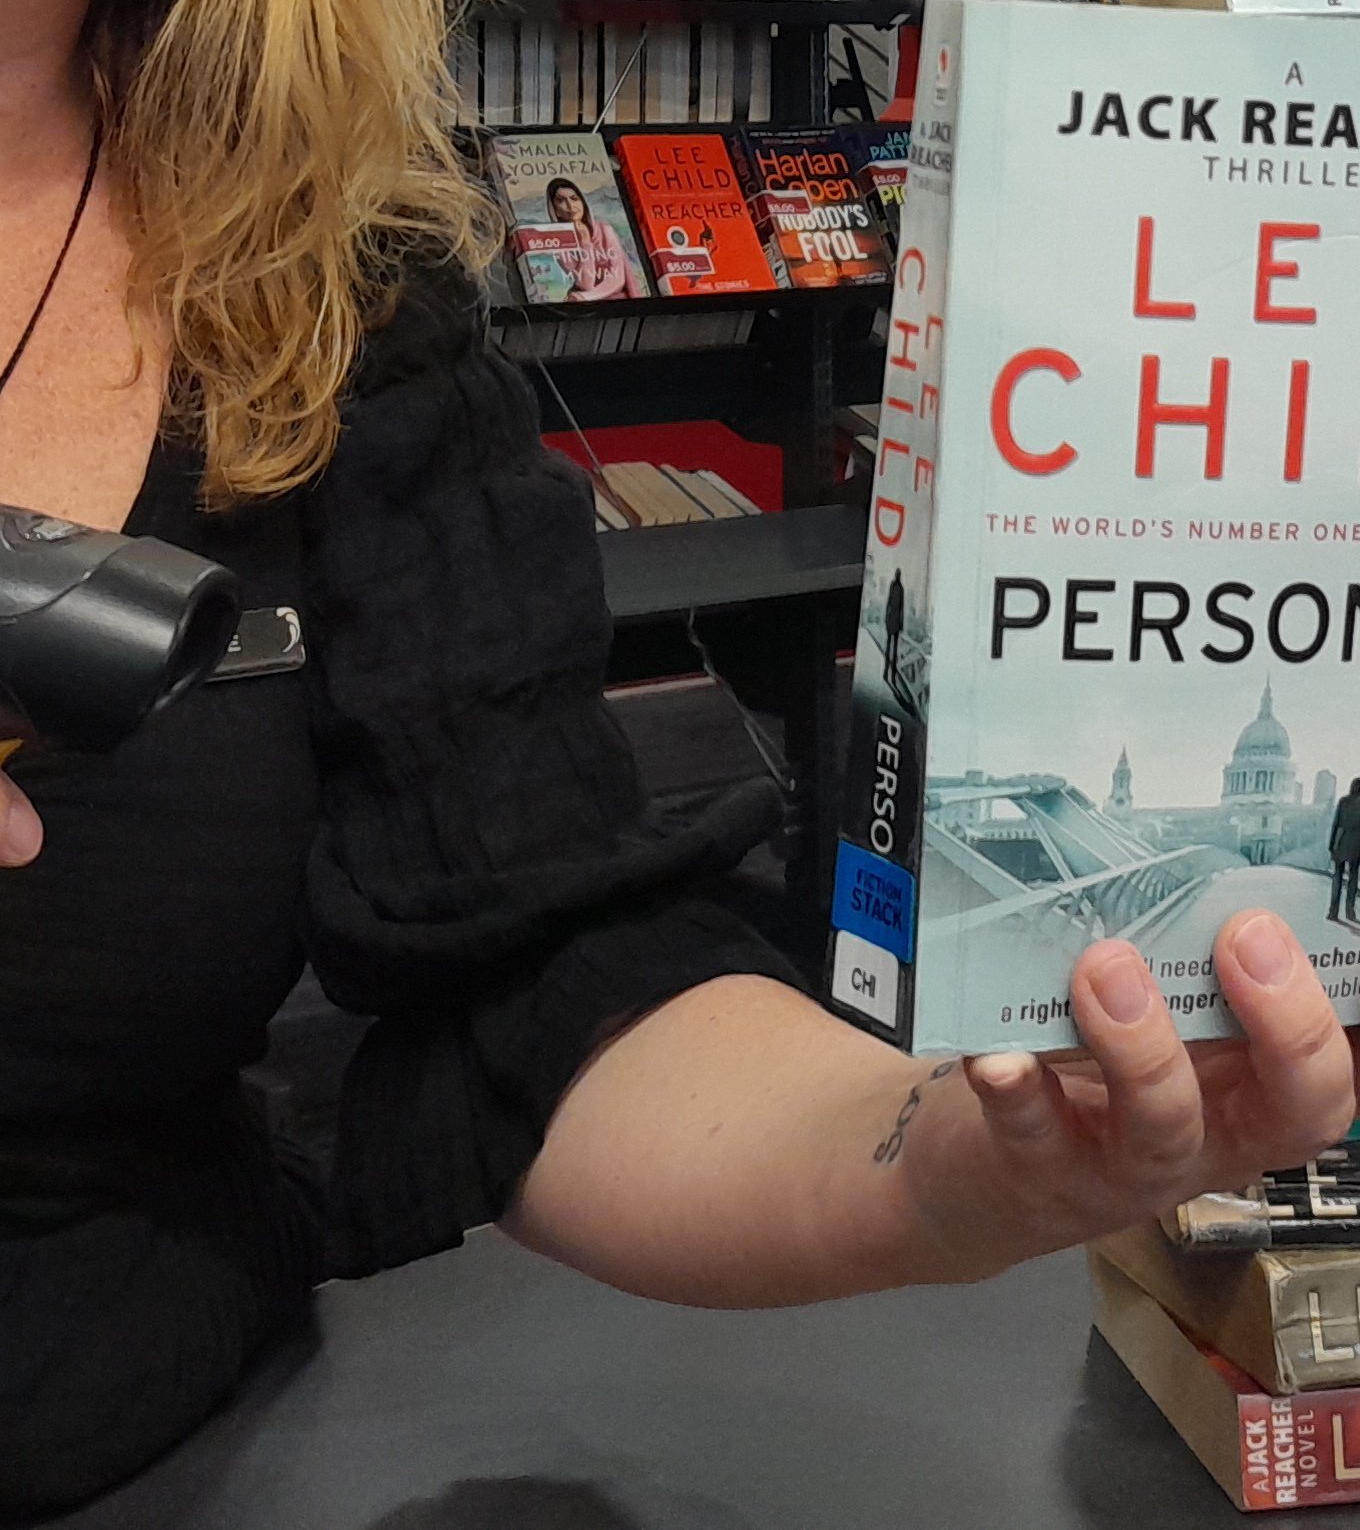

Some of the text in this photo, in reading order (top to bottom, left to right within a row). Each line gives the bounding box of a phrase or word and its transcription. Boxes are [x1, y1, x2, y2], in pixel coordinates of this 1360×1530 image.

[1285, 62, 1304, 86] A
[1058, 90, 1220, 143] JACK
[519, 142, 588, 158] MALALA
[653, 145, 706, 166] LEE
[755, 147, 850, 178] Harlan
[507, 160, 608, 178] YOUSAFZAI
[642, 168, 732, 192] CHILD
[652, 201, 745, 221] REACHER
[776, 203, 870, 232] NOBODY'S
[552, 247, 619, 264] FINDING
[797, 229, 869, 263] FOOL
[874, 246, 927, 549] CHILD
[914, 314, 944, 494] LEE
[986, 513, 1038, 535] THE
[1051, 515, 1175, 541] WORLD'S
[1187, 518, 1302, 543] NUMBER
[870, 713, 902, 855] PERSO
[856, 868, 903, 903] FICTION
[850, 886, 904, 933] STACK
[1159, 956, 1214, 978] need
[850, 967, 876, 1000] CHI
[1019, 998, 1071, 1026] right
[1244, 1417, 1271, 1492] A JACK
[1271, 1398, 1298, 1504] REACHER
[1296, 1409, 1318, 1489] NOVEL
